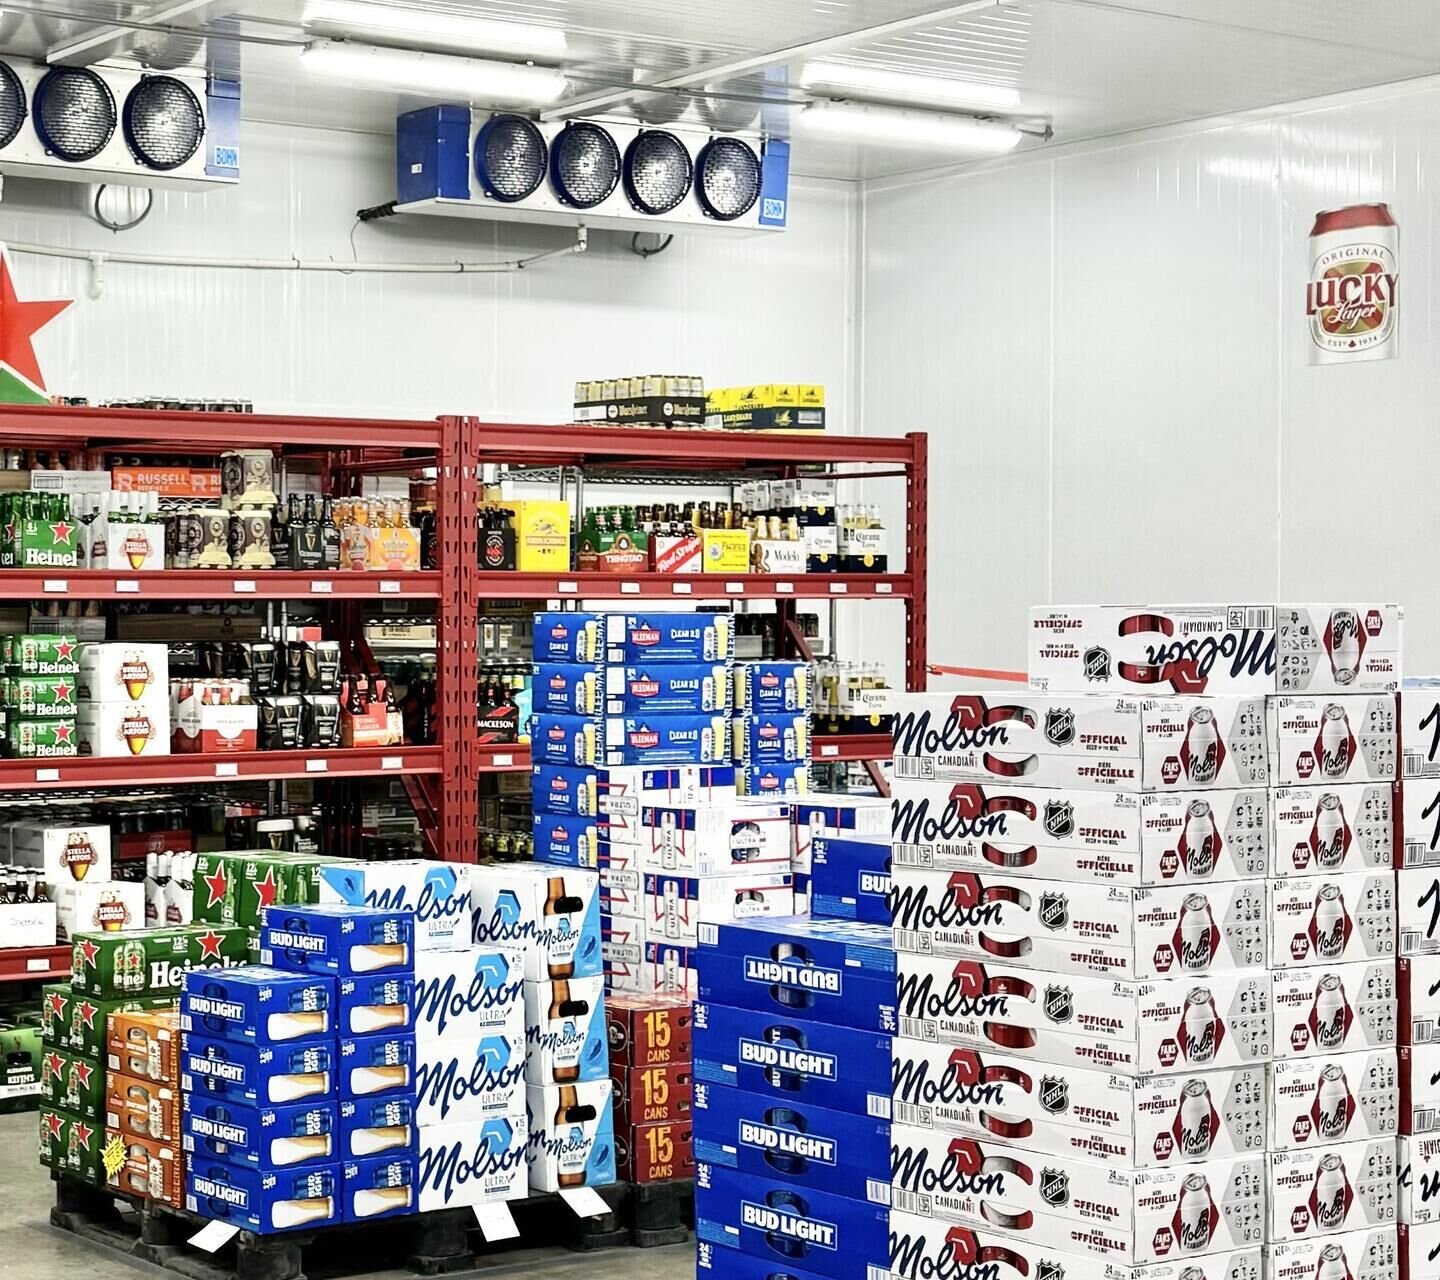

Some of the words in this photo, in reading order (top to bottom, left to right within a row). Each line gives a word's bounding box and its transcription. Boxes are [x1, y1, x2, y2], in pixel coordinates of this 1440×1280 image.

[216, 147, 239, 167] BOHN
[1322, 247, 1386, 266] ORIGINAL
[1306, 272, 1400, 316] LUCKY
[1327, 299, 1377, 329] Lager
[138, 474, 188, 485] RUSSELL
[605, 554, 643, 564] TSINGTAO
[774, 551, 800, 562] Modelo
[894, 710, 1009, 758] Molson
[1147, 723, 1185, 733] OFFICIELLE
[1080, 734, 1127, 745] OFFICIAL
[938, 750, 975, 768] CANADIAN
[1077, 766, 1135, 778] OFFICIELLE
[892, 797, 1008, 845] Molson
[1079, 828, 1127, 840] OFFICIAL
[67, 847, 91, 856] STELLA
[936, 840, 974, 857] CANADIAN
[67, 854, 91, 863] ARTOIS
[1076, 860, 1134, 872] OFFICIELLE
[99, 906, 125, 914] STELLA
[99, 913, 125, 921] ARTOIS
[891, 885, 1004, 932] Molson
[1073, 920, 1120, 934] OFFICIAL
[270, 932, 293, 947] BUD
[294, 936, 325, 951] LIGHT
[1070, 952, 1128, 967] OFFICIELLE
[415, 973, 525, 1035] Molson
[897, 971, 1009, 1019] Molson
[189, 998, 211, 1014] BUD
[211, 1002, 242, 1020] LIGHT
[480, 1009, 508, 1020] ULTRA
[644, 1012, 671, 1048] 15
[1078, 1014, 1124, 1028] OFFICIAL
[648, 1050, 671, 1062] CANS
[742, 1044, 776, 1065] BUD
[780, 1051, 834, 1077] LIGHT
[190, 1058, 212, 1074] BUD
[212, 1064, 243, 1083] LIGHT
[416, 1059, 526, 1118] Molson
[643, 1068, 668, 1105] 15
[892, 1058, 1005, 1106] Molson
[482, 1092, 509, 1103] ULTRA
[644, 1107, 668, 1119] CANS
[192, 1118, 214, 1135] BUD
[214, 1125, 246, 1144] LIGHT
[647, 1126, 674, 1162] 15
[742, 1126, 776, 1146] BUD
[780, 1133, 834, 1161] LIGHT
[420, 1138, 531, 1203] Molson
[649, 1165, 673, 1178] CANS
[891, 1144, 1006, 1198] Molson
[744, 1207, 778, 1227] BUD
[781, 1214, 834, 1245] LIGHT
